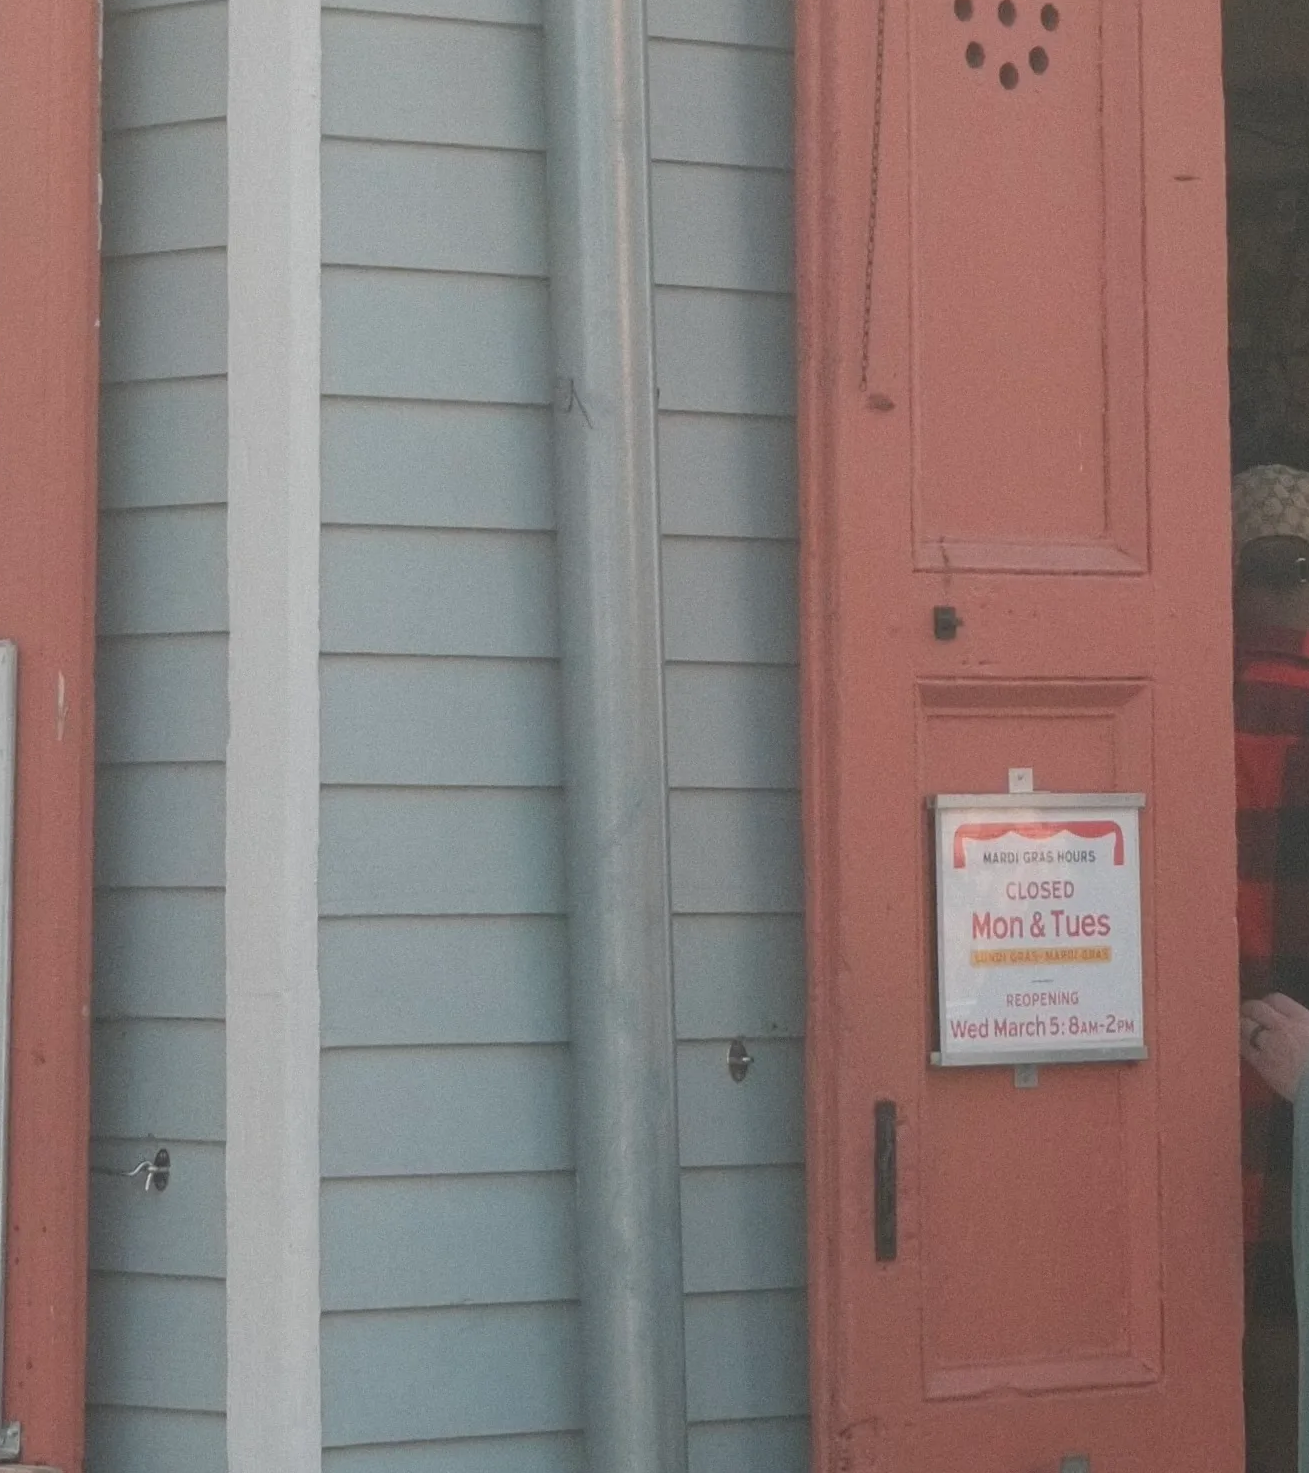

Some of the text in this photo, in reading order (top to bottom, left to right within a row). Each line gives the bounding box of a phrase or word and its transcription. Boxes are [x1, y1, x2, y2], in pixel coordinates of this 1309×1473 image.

[983, 849, 1097, 865] MARDI GRAS HOURS
[1006, 880, 1076, 901] CLOSED
[971, 908, 1112, 941] Mon & Tues
[1006, 990, 1080, 1008] REOPENING
[950, 1016, 990, 1040] Wed
[993, 1015, 1047, 1039] March
[1068, 1013, 1136, 1035] 8AM-2PM
